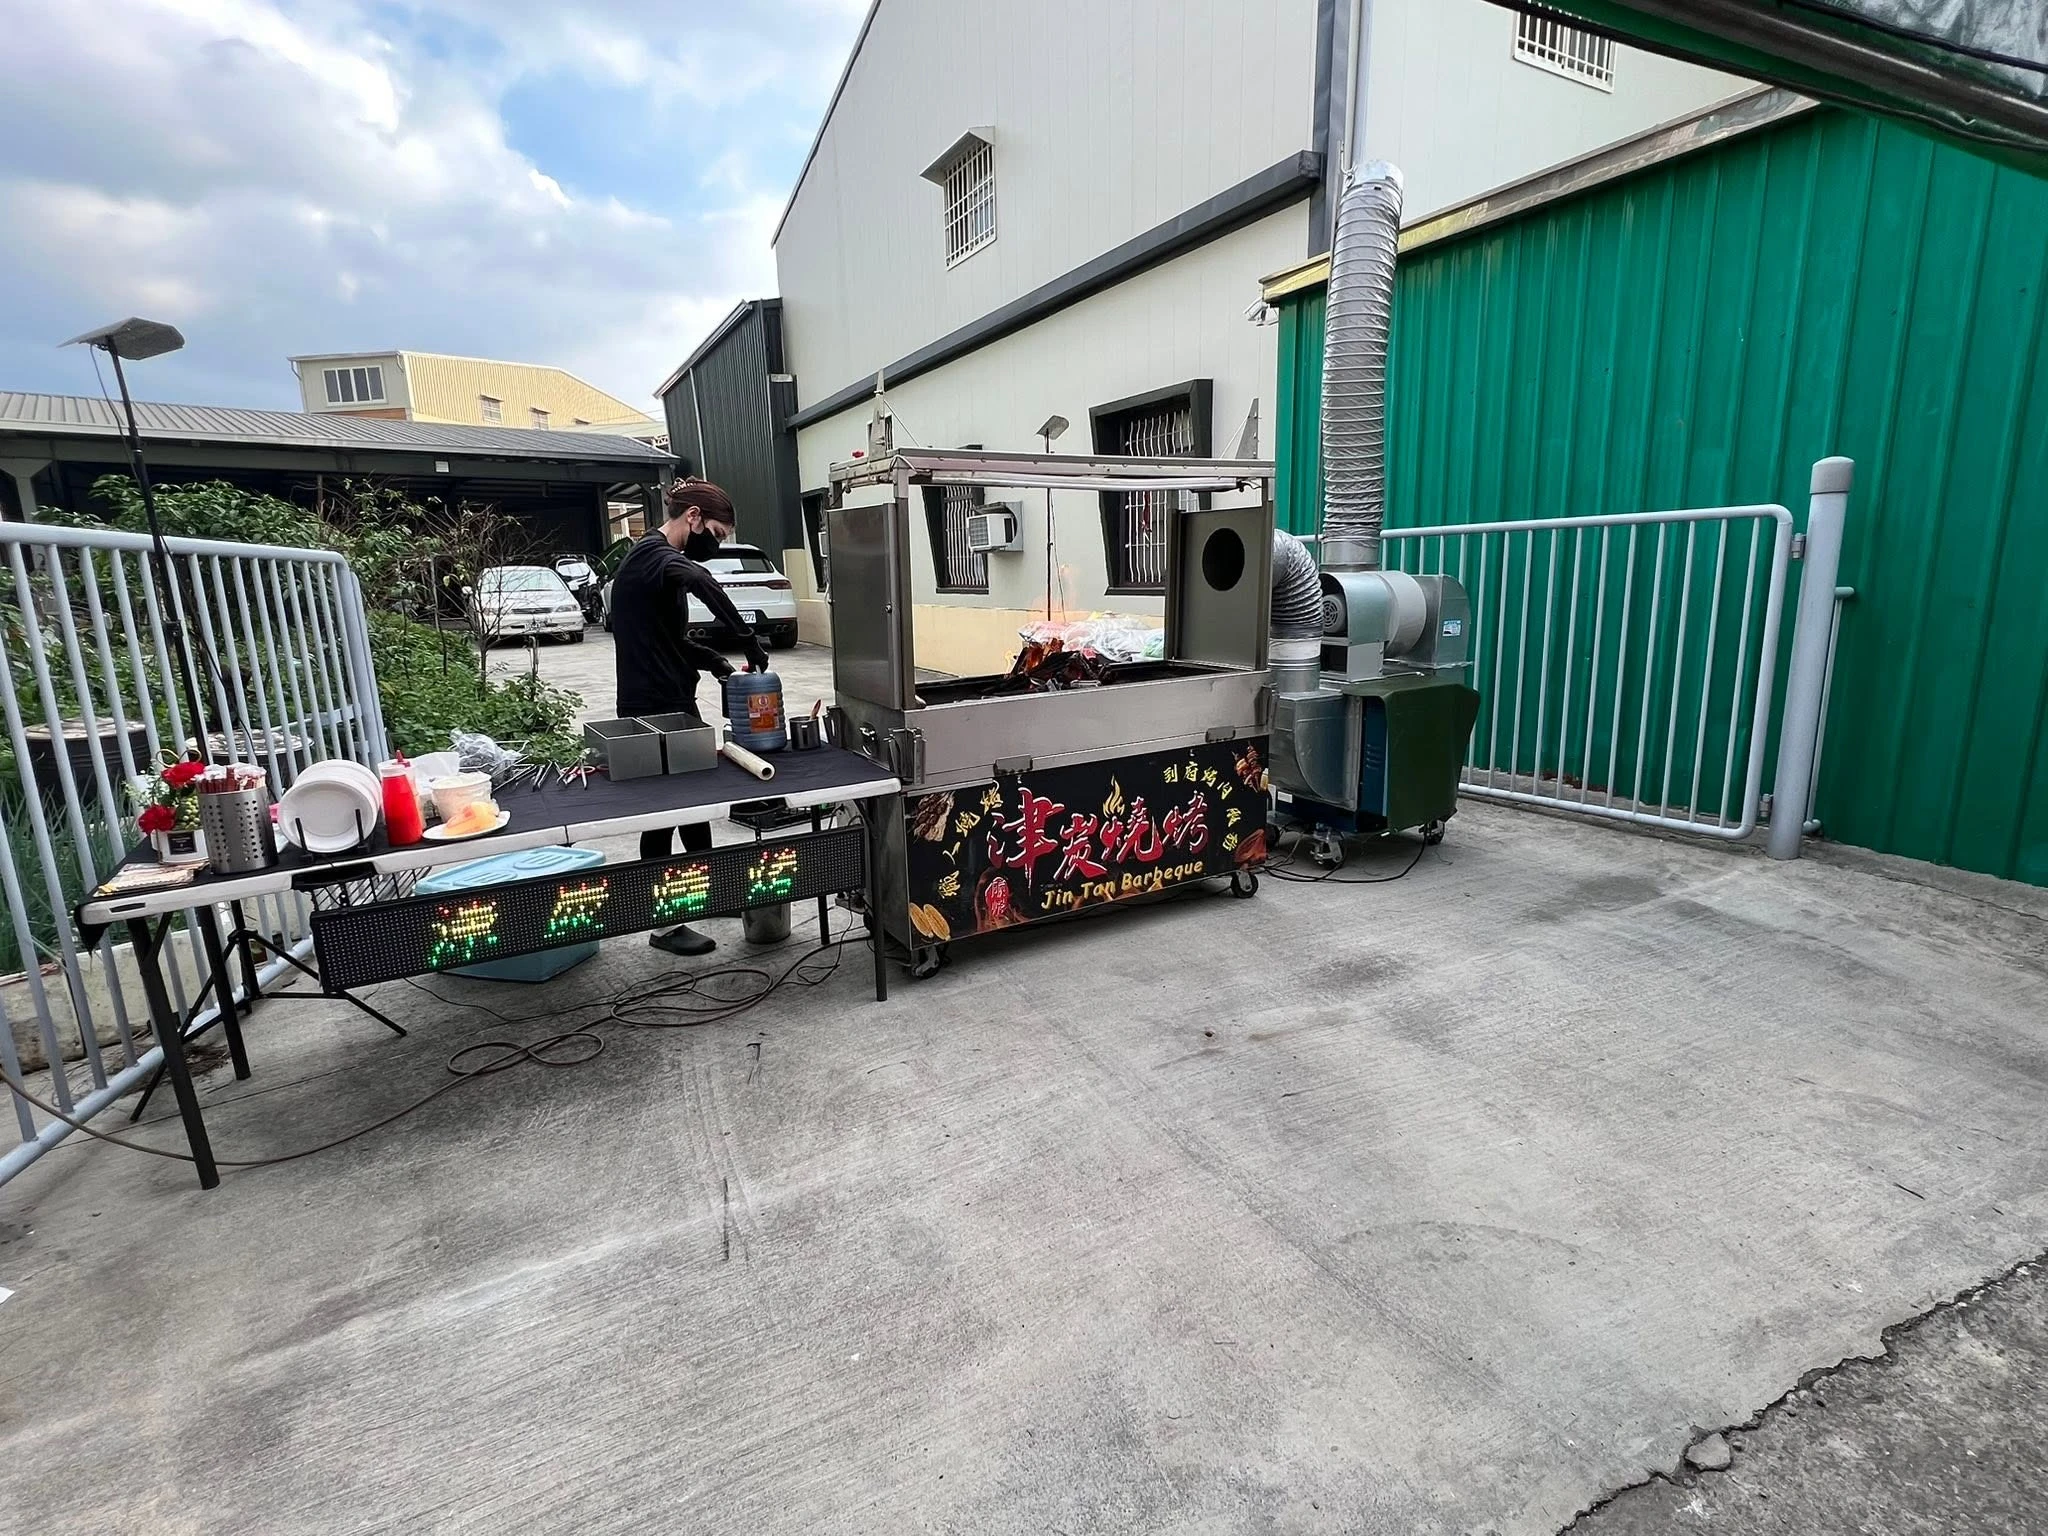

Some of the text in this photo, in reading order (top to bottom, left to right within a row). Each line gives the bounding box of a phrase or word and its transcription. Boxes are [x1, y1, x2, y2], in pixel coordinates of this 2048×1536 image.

[986, 787, 1209, 895] 津炭燒烤
[1040, 859, 1204, 910] Jin Tan Barbeque
